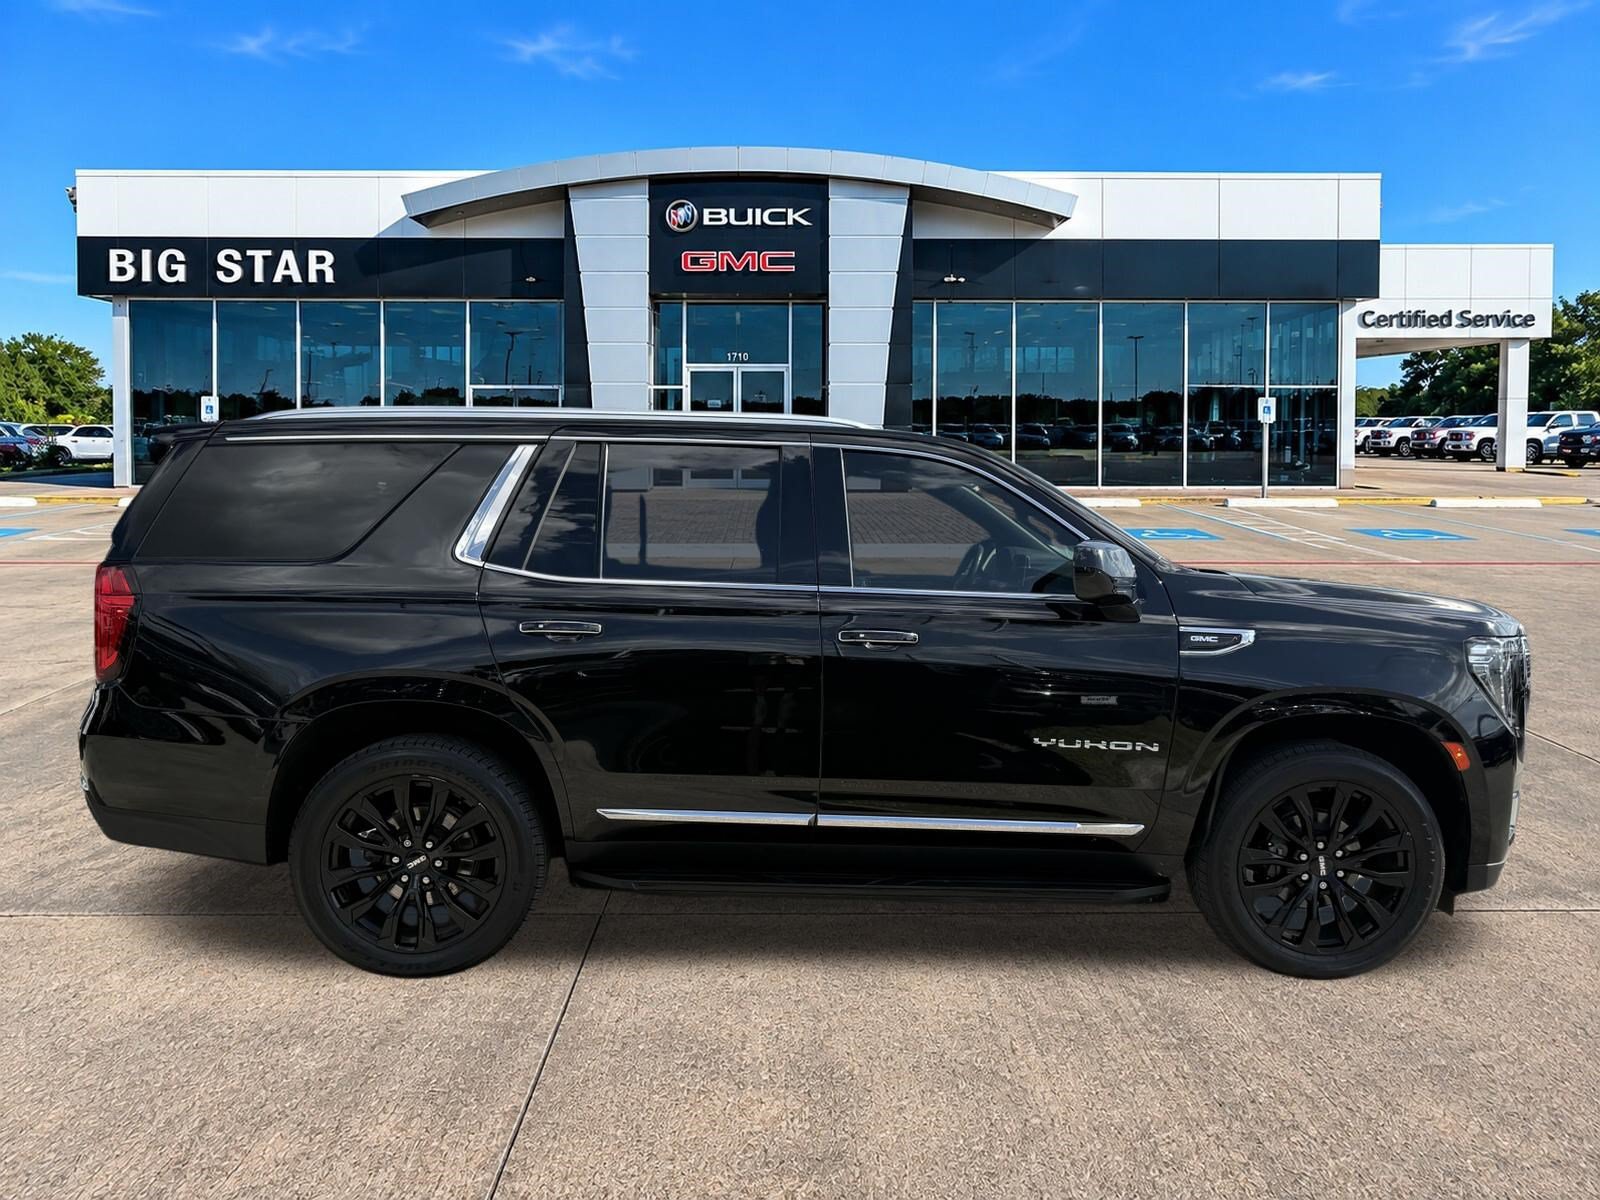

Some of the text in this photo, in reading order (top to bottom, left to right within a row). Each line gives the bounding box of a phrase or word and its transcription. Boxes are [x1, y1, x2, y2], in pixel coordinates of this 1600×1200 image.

[703, 208, 813, 226] BUICK
[108, 248, 336, 284] BIG STAR
[681, 251, 795, 272] GMC
[1359, 309, 1535, 329] Certified Service
[727, 352, 749, 361] 1710
[1190, 635, 1218, 643] GMC
[1033, 737, 1159, 752] YUKON
